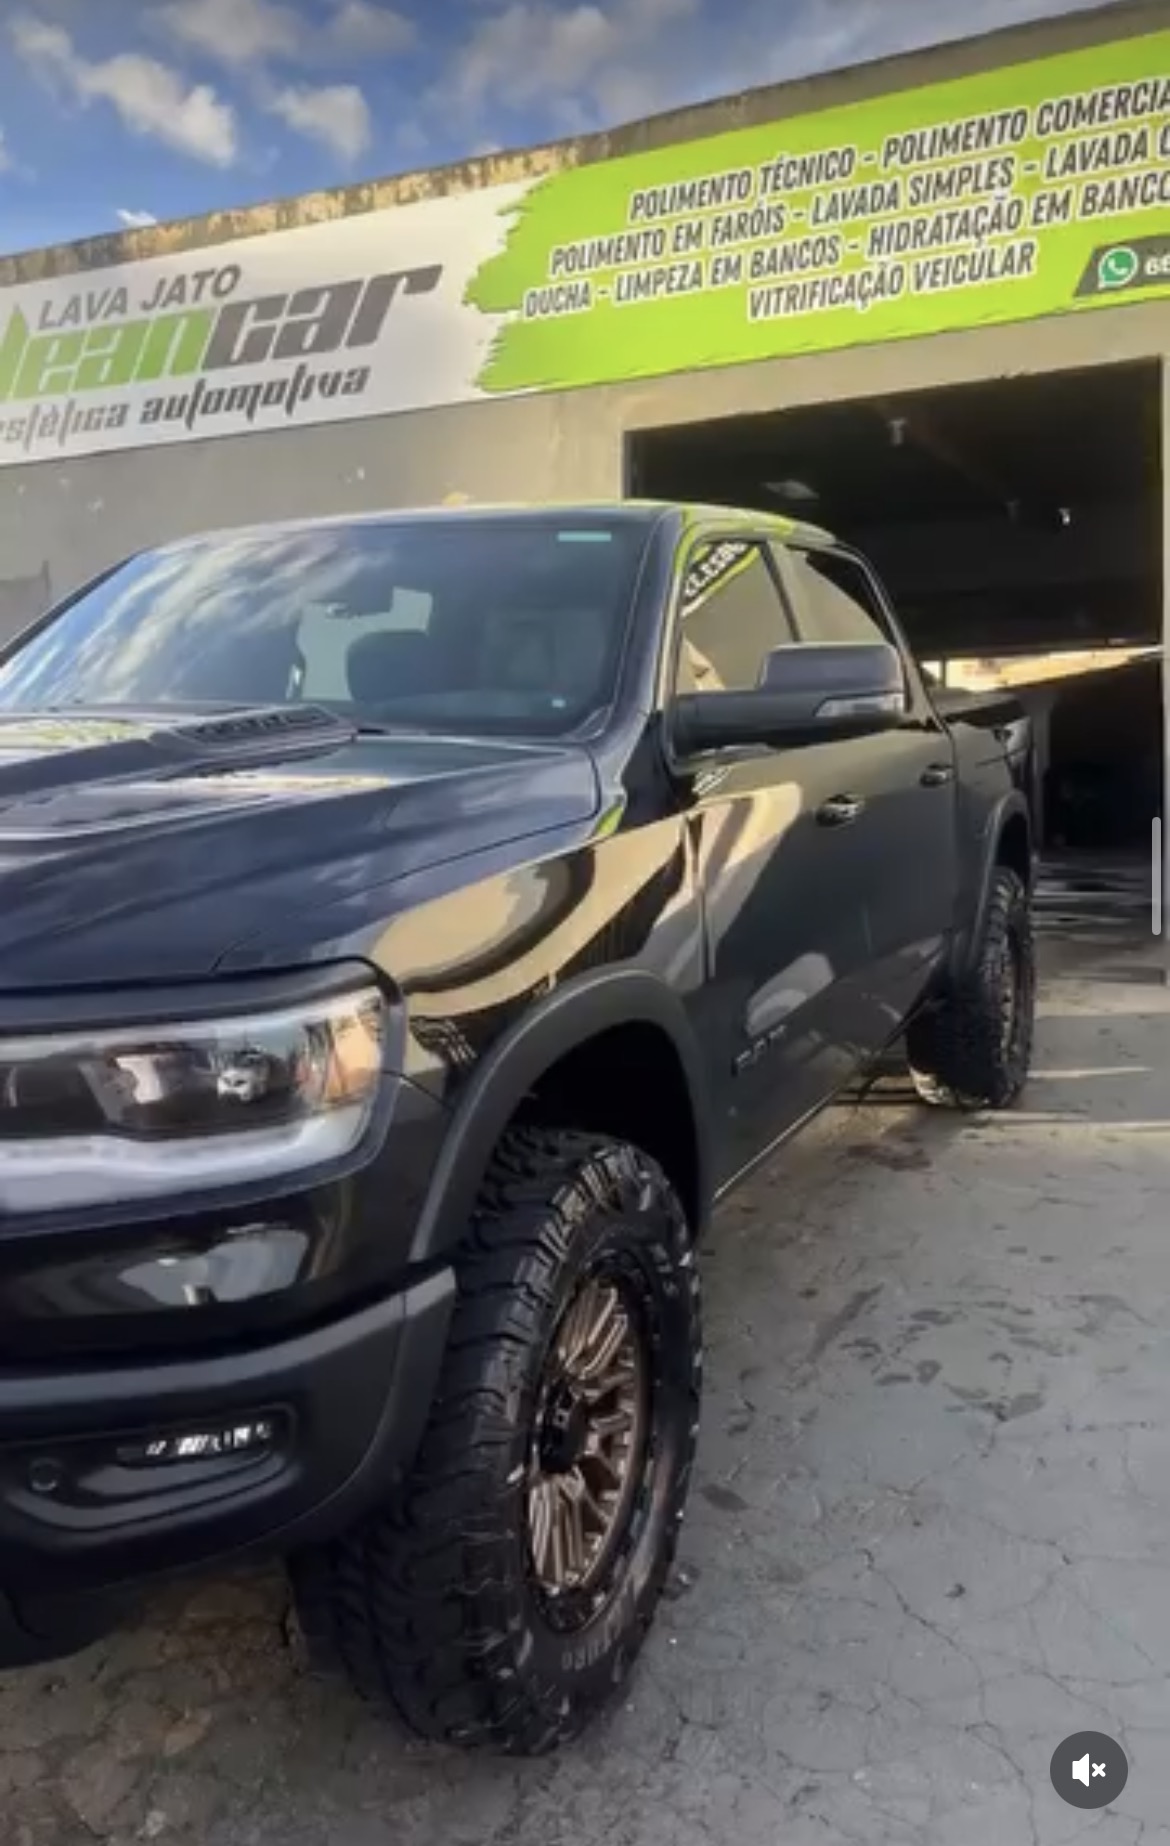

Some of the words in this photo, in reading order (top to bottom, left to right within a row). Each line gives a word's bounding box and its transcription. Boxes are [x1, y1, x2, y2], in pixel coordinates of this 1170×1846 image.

[551, 227, 666, 275] POLIMENTO
[673, 222, 703, 251] EM
[711, 200, 785, 246] FARÓIS
[813, 183, 898, 224] LAVADA
[910, 157, 1015, 206] SIMPLES
[1046, 130, 1148, 177] LAVADA
[631, 169, 750, 220] POLIMENTO
[760, 148, 855, 193] TÉCNICO
[883, 110, 1027, 167] POLIMENTO
[616, 261, 702, 301] LIMPEZA
[711, 255, 742, 284] EM
[751, 235, 840, 279] BANCOS
[868, 195, 1022, 256] HIDRATAÇÃO
[1032, 189, 1071, 224] EM
[750, 261, 903, 317] VITRIFICAÇÃO
[915, 242, 1034, 290] VEICULAR
[38, 286, 128, 330] LAVA
[141, 264, 241, 309] JATO
[140, 363, 370, 431] automotiva
